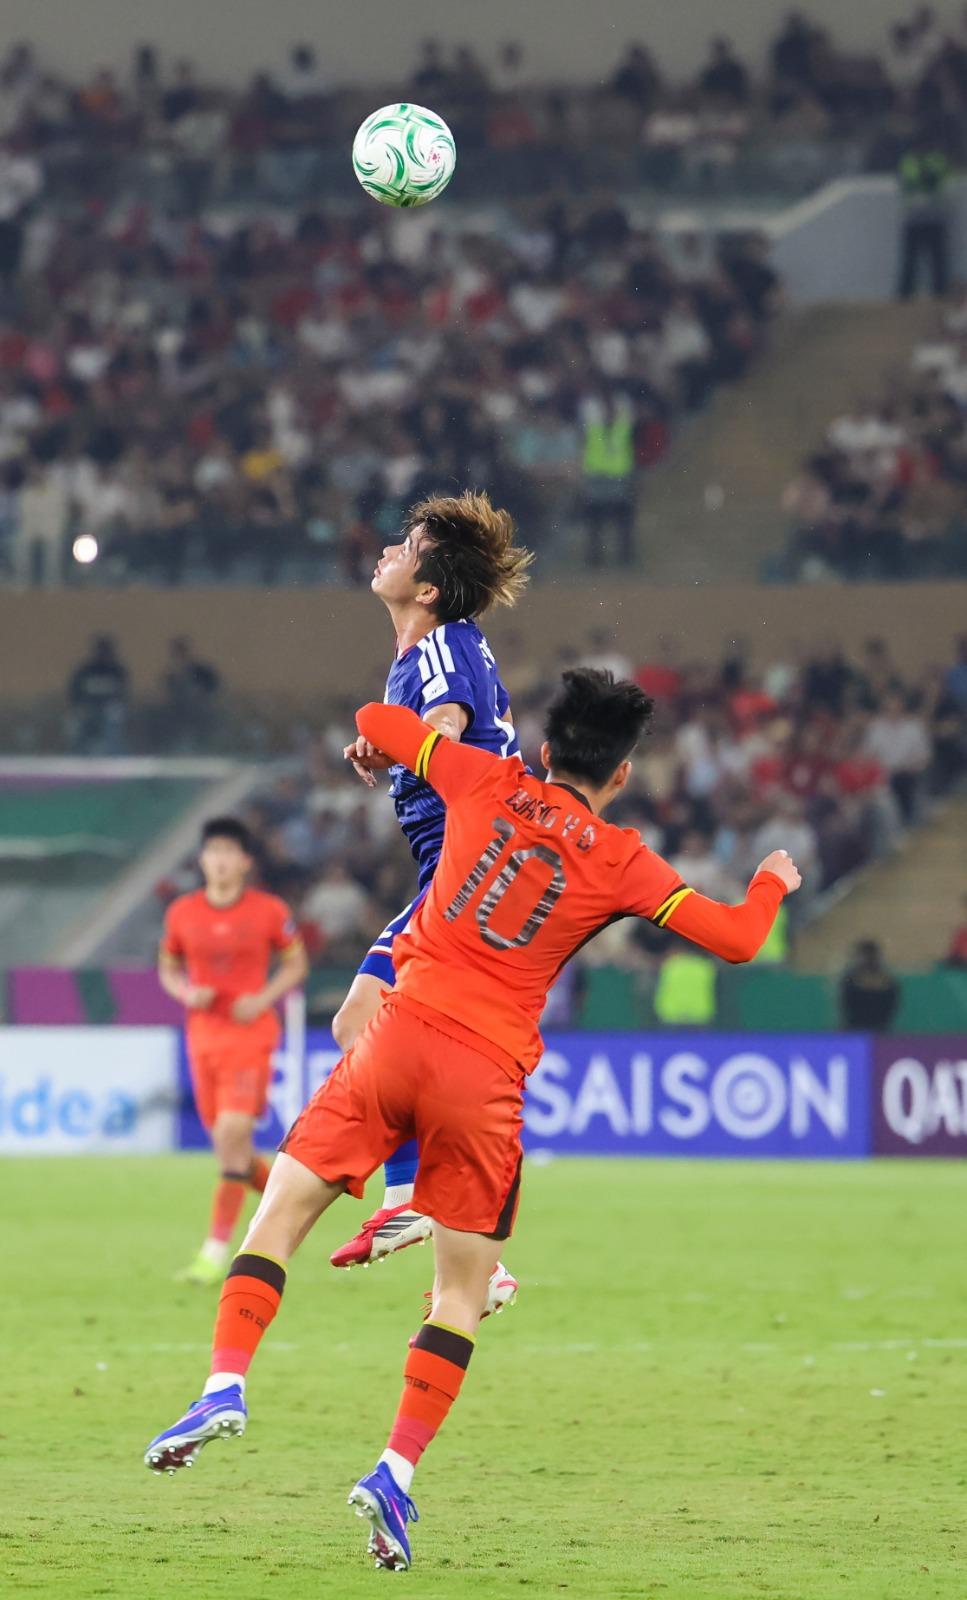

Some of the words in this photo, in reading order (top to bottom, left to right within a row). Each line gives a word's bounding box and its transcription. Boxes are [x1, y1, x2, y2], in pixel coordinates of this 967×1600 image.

[505, 788, 561, 829] WANG
[442, 816, 567, 951] 10
[523, 1051, 848, 1139] SAISON
